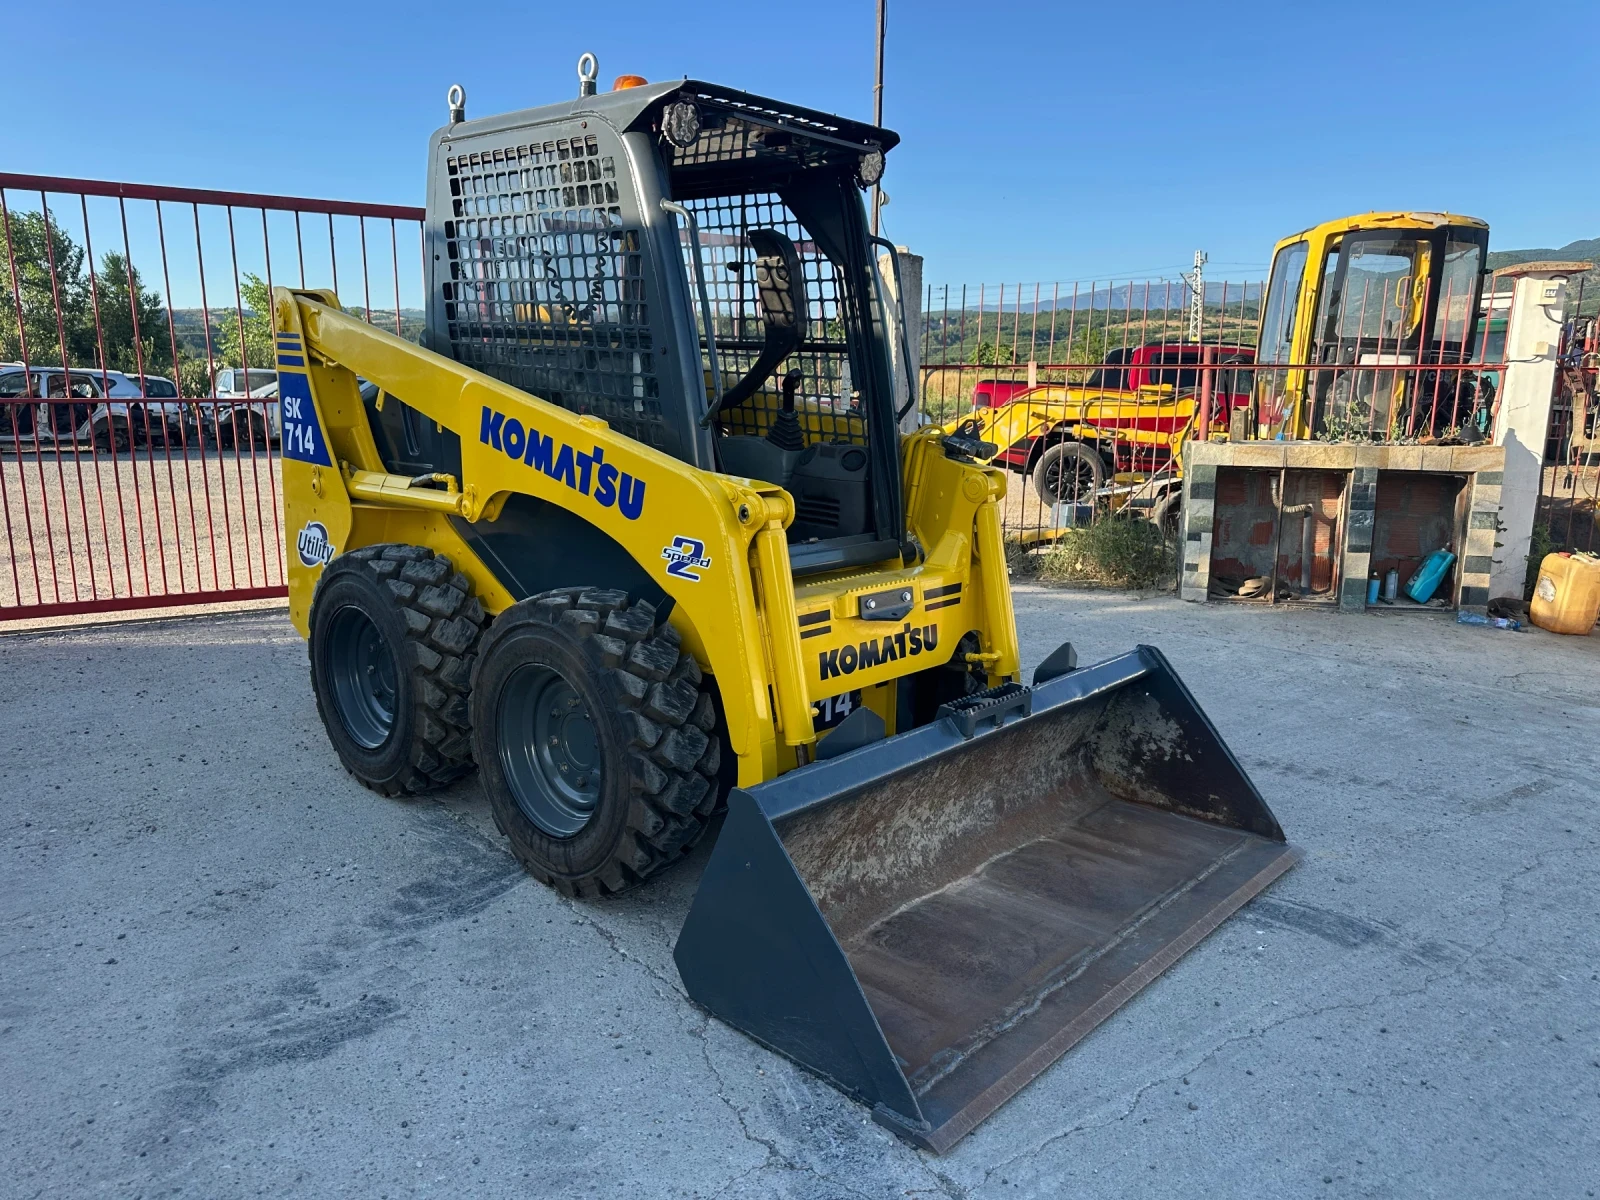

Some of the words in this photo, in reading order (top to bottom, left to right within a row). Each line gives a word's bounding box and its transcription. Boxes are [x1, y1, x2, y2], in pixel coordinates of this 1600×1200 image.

[284, 396, 302, 419] SK
[284, 421, 315, 455] 714
[480, 405, 646, 520] KOMATSU
[298, 531, 335, 566] Utility
[667, 536, 704, 581] 2
[819, 622, 938, 681] KOMATSU
[811, 691, 852, 722] 14
